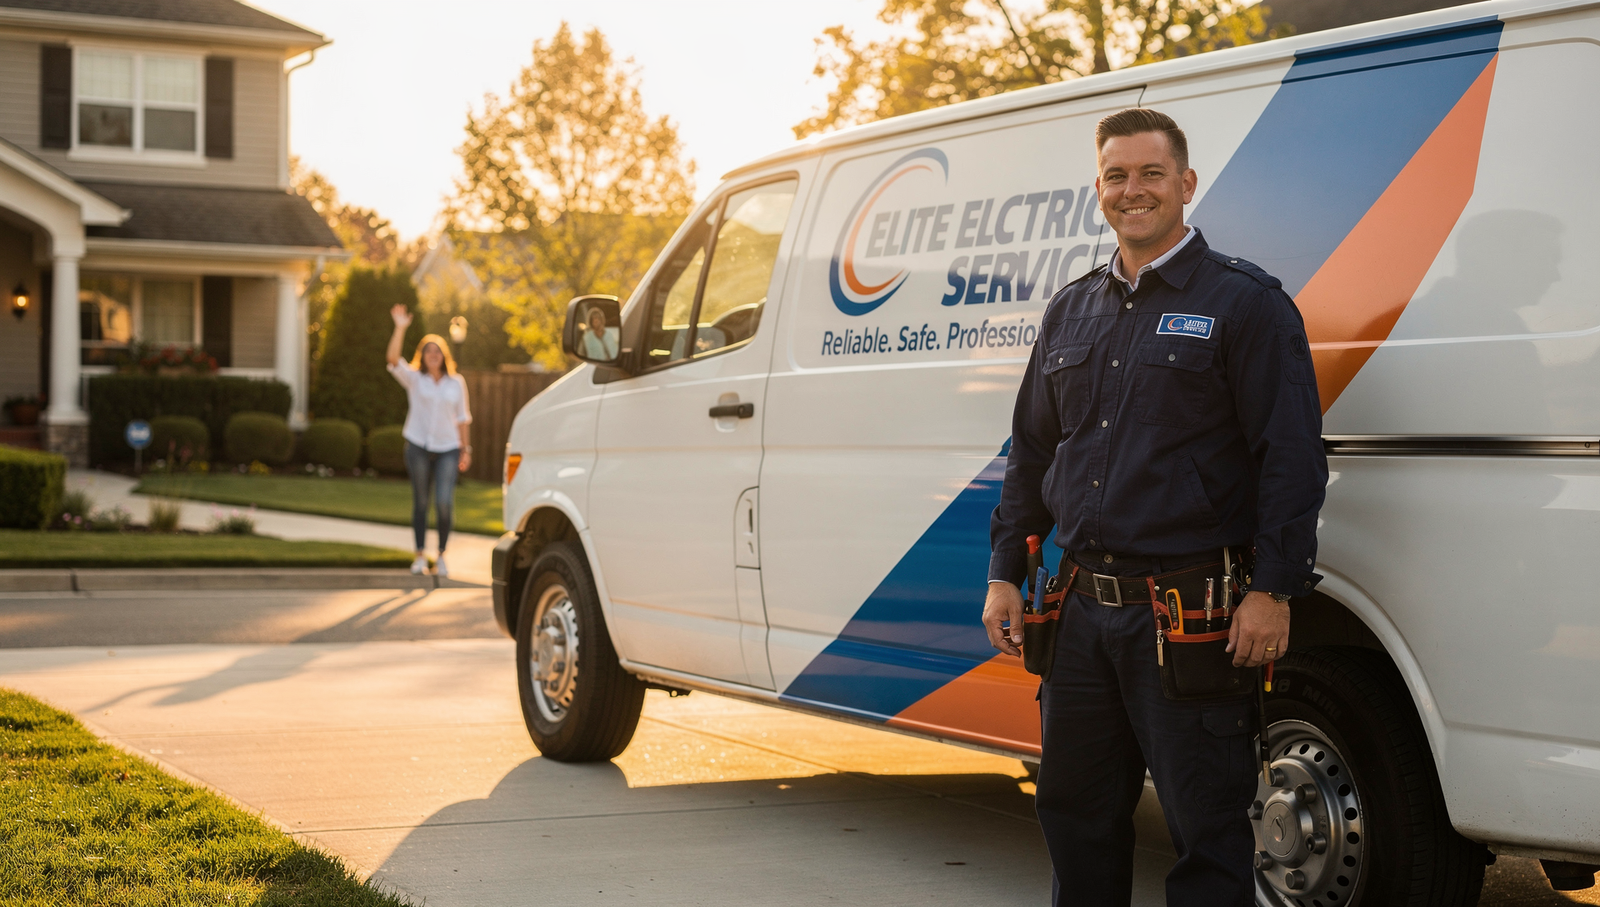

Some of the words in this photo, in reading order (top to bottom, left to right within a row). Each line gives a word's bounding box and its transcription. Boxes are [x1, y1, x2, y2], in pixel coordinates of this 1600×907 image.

[865, 203, 955, 259] ELITE
[821, 327, 892, 356] Reliable.
[897, 323, 940, 352] Safe.
[946, 318, 1040, 350] Professio
